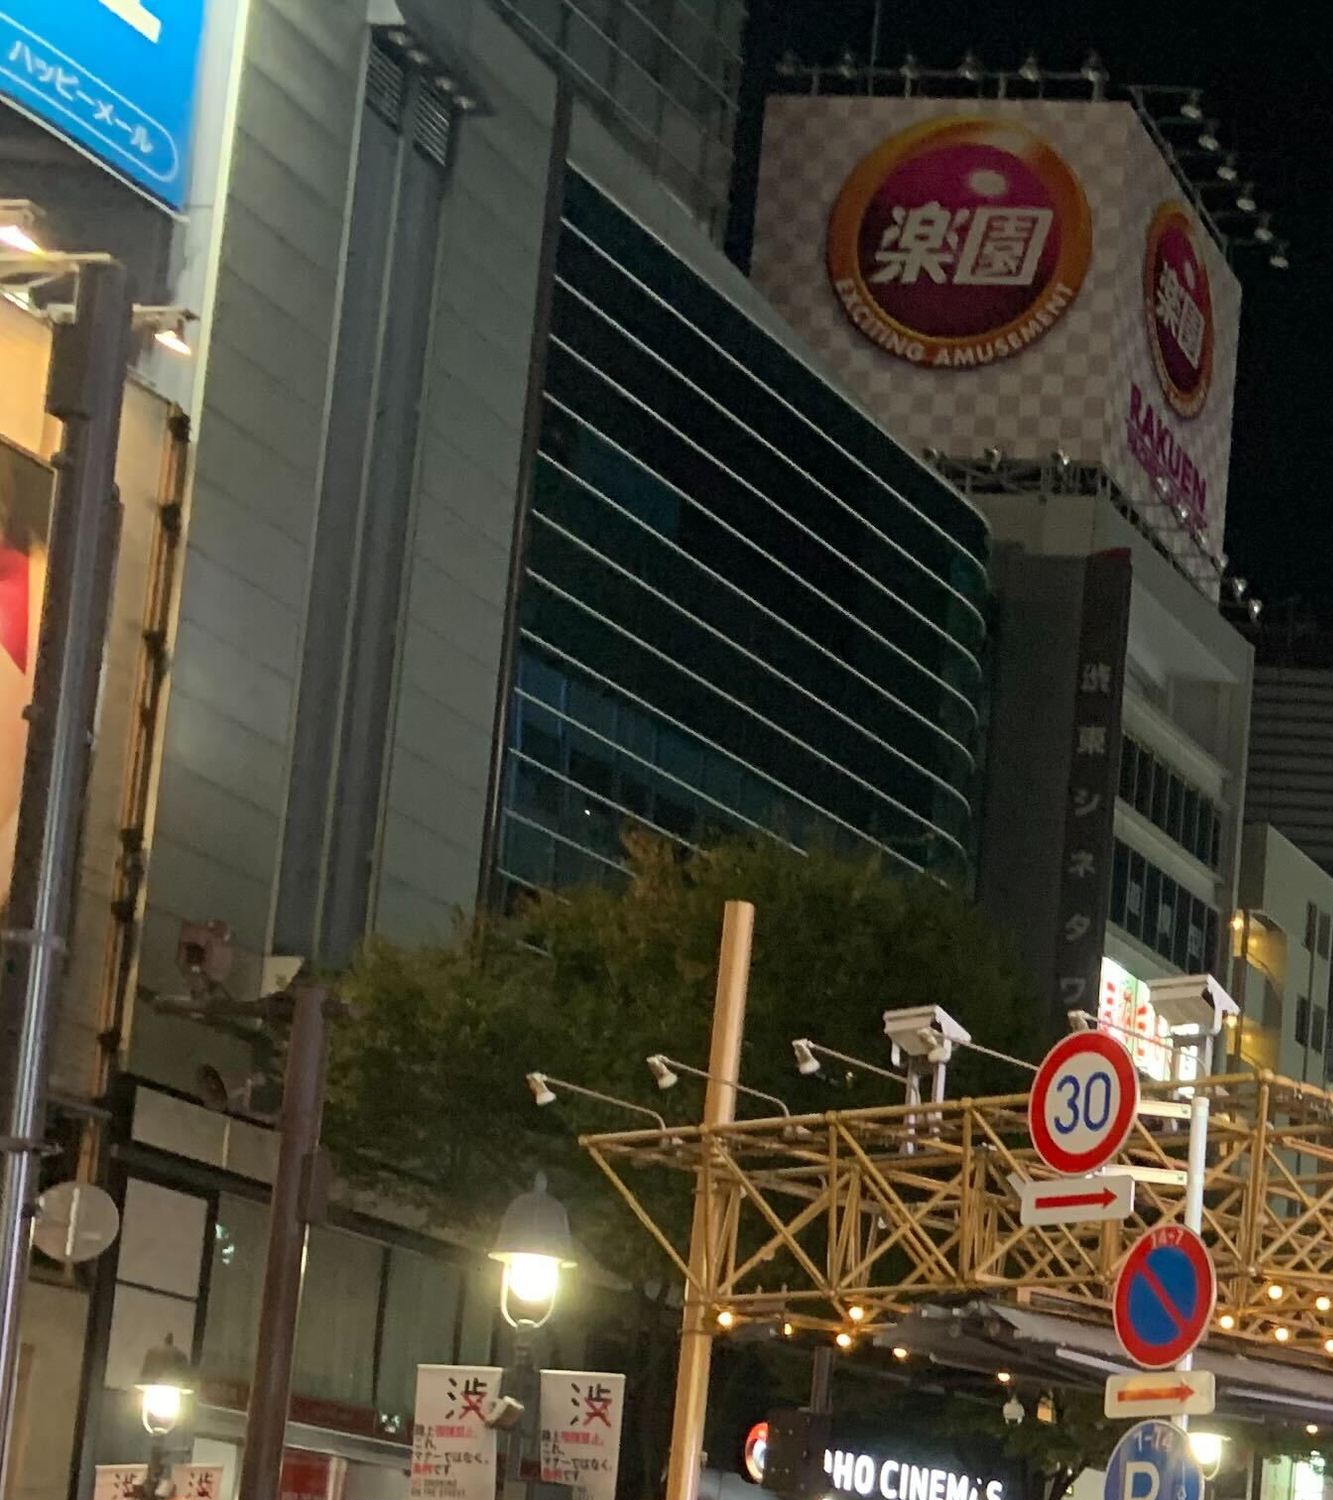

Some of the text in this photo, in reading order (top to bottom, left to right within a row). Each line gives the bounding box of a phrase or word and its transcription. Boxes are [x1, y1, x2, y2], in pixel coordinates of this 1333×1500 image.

[7, 40, 155, 154] ハッピーメール
[869, 200, 1054, 286] 楽園
[834, 277, 926, 363] EXCITING
[932, 282, 1074, 368] AMUSEMENT
[1129, 381, 1207, 515] RAKUEN
[1053, 1071, 1112, 1134] 30
